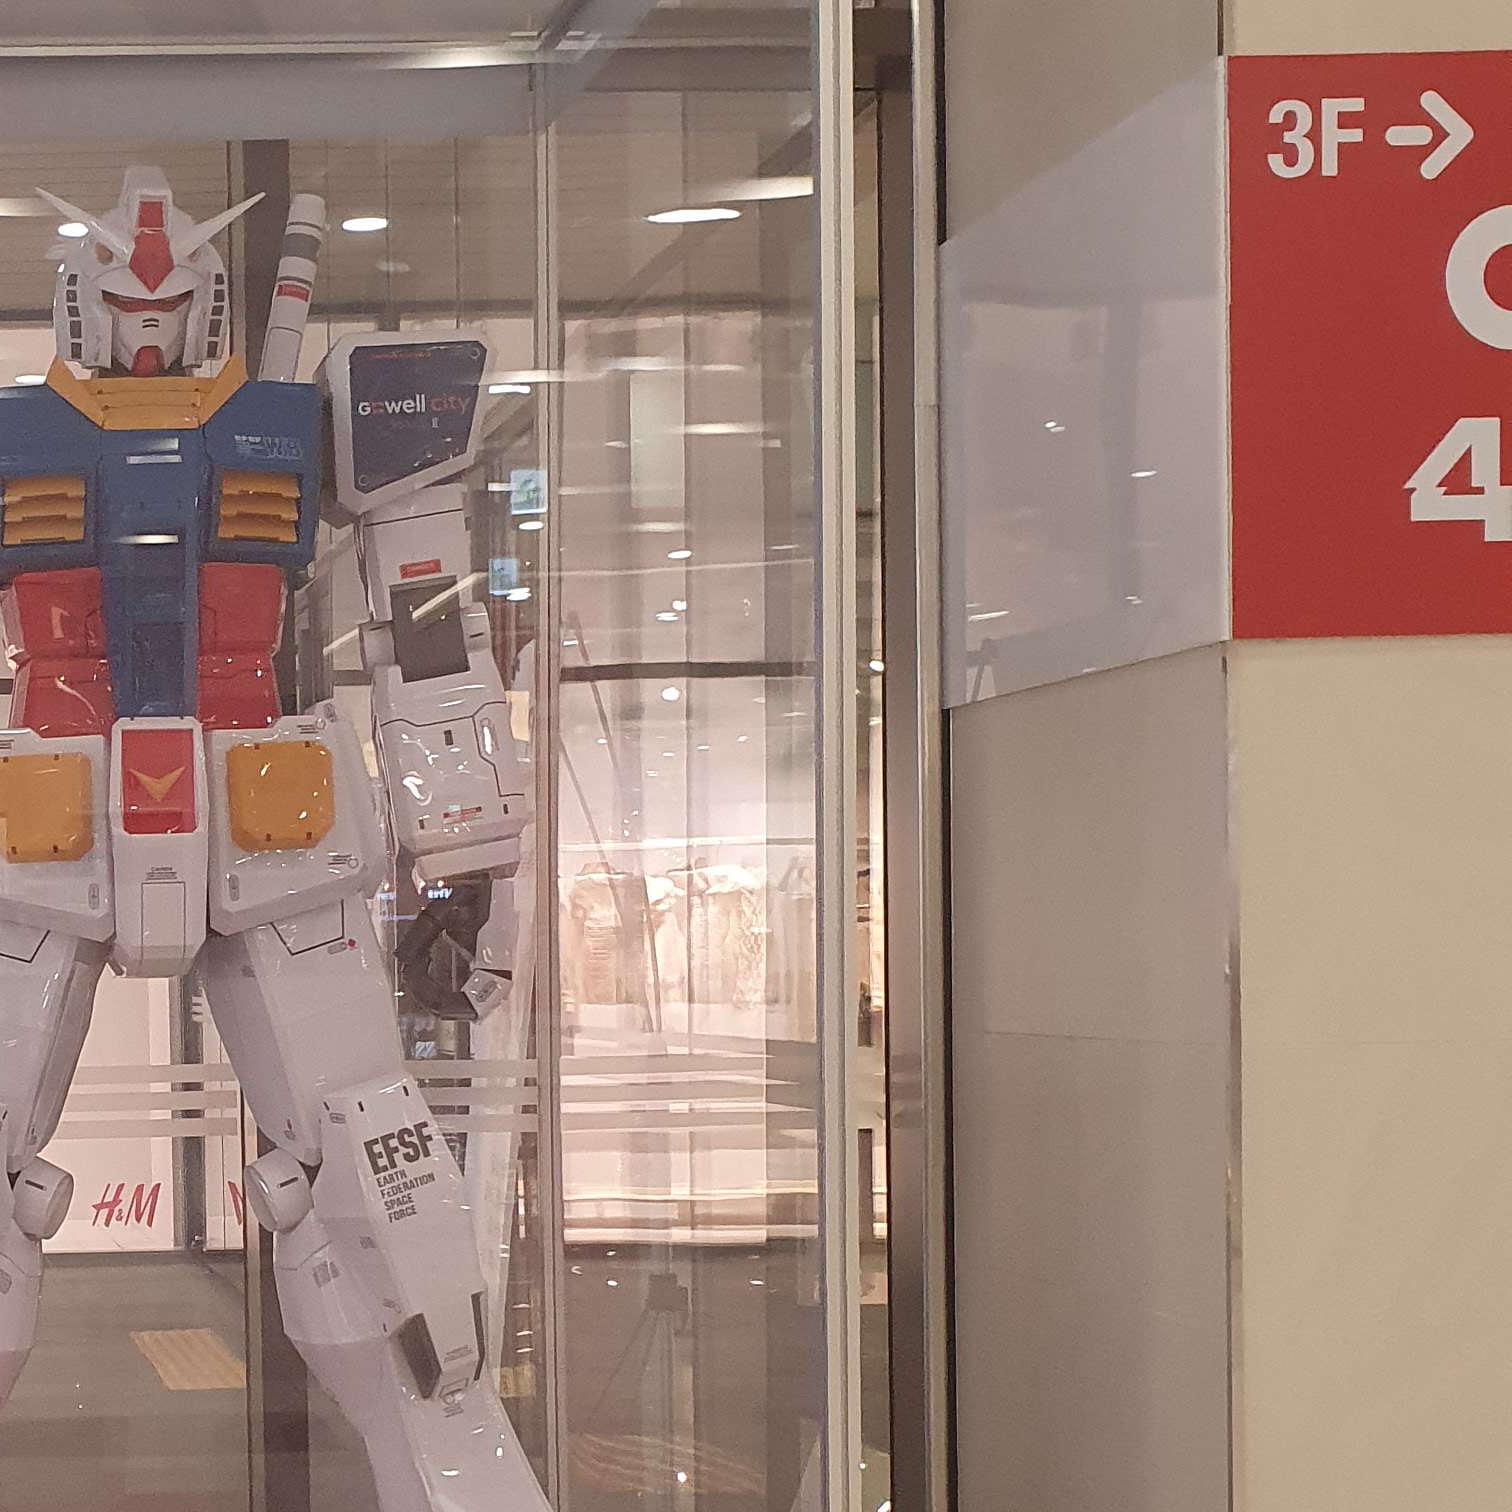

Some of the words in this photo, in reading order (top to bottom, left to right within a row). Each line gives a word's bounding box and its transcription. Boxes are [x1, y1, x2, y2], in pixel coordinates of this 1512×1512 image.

[1267, 97, 1365, 178] 3F
[363, 1121, 433, 1176] EFSF
[376, 1169, 407, 1188] EARTH
[380, 1172, 436, 1199] FEDERATION
[92, 1182, 161, 1228] H&M
[384, 1193, 415, 1211] SPACE
[388, 1204, 418, 1223] FORCE
